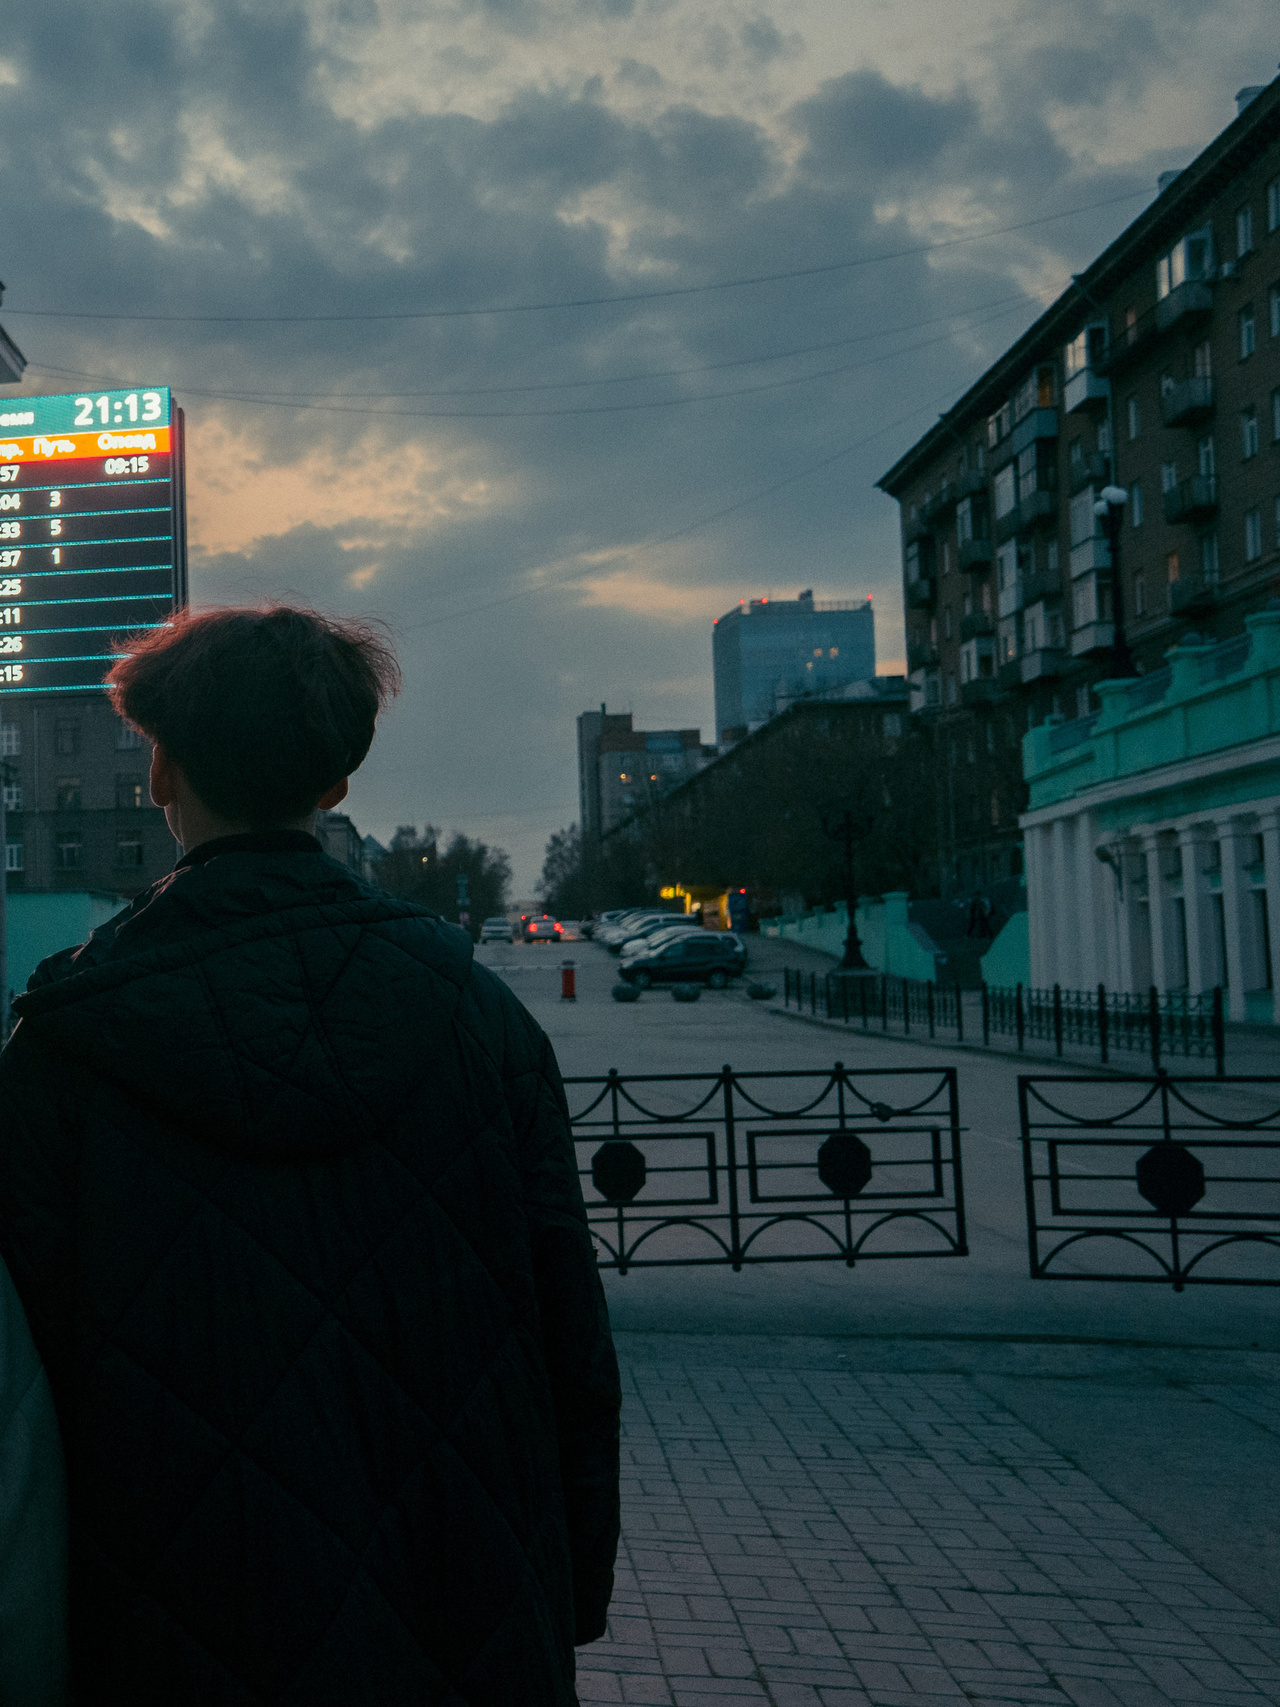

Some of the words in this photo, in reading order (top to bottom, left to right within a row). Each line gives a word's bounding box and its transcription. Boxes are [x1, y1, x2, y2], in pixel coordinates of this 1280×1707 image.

[73, 390, 162, 427] 21:13
[33, 437, 76, 458] Путь
[104, 455, 149, 475] 09:15
[49, 490, 61, 507] 3
[50, 518, 62, 536] 5
[51, 547, 61, 564] 1
